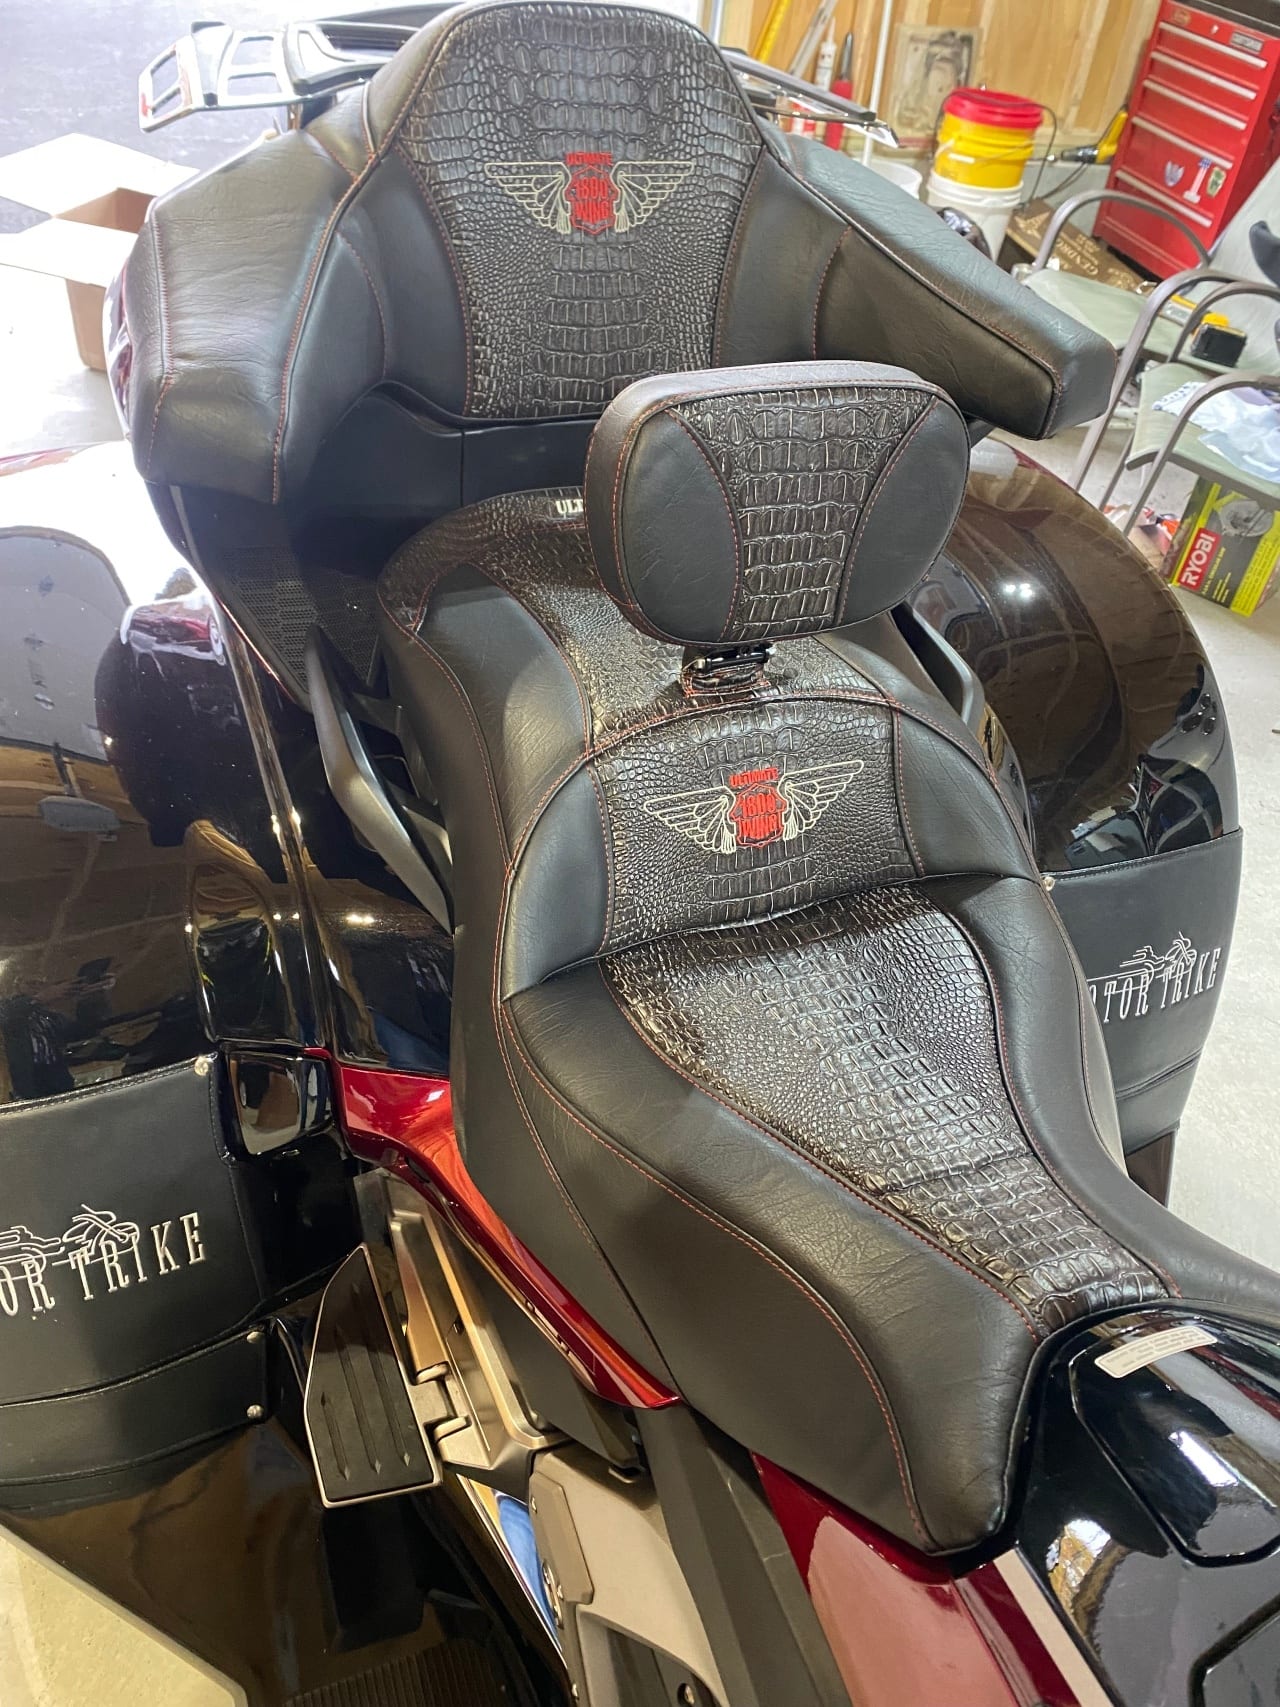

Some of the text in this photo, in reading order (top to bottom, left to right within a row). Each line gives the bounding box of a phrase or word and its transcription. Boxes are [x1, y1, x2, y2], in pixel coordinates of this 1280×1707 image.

[567, 152, 612, 165] ULTIMATE
[575, 177, 608, 199] 1800
[576, 201, 608, 222] WING
[1181, 532, 1217, 586] RYOBI
[730, 768, 778, 786] ULTIMATE
[741, 792, 776, 818] 1800
[743, 814, 776, 838] WING
[1160, 947, 1221, 1009] TRIKE
[68, 1211, 206, 1301] TRIKE
